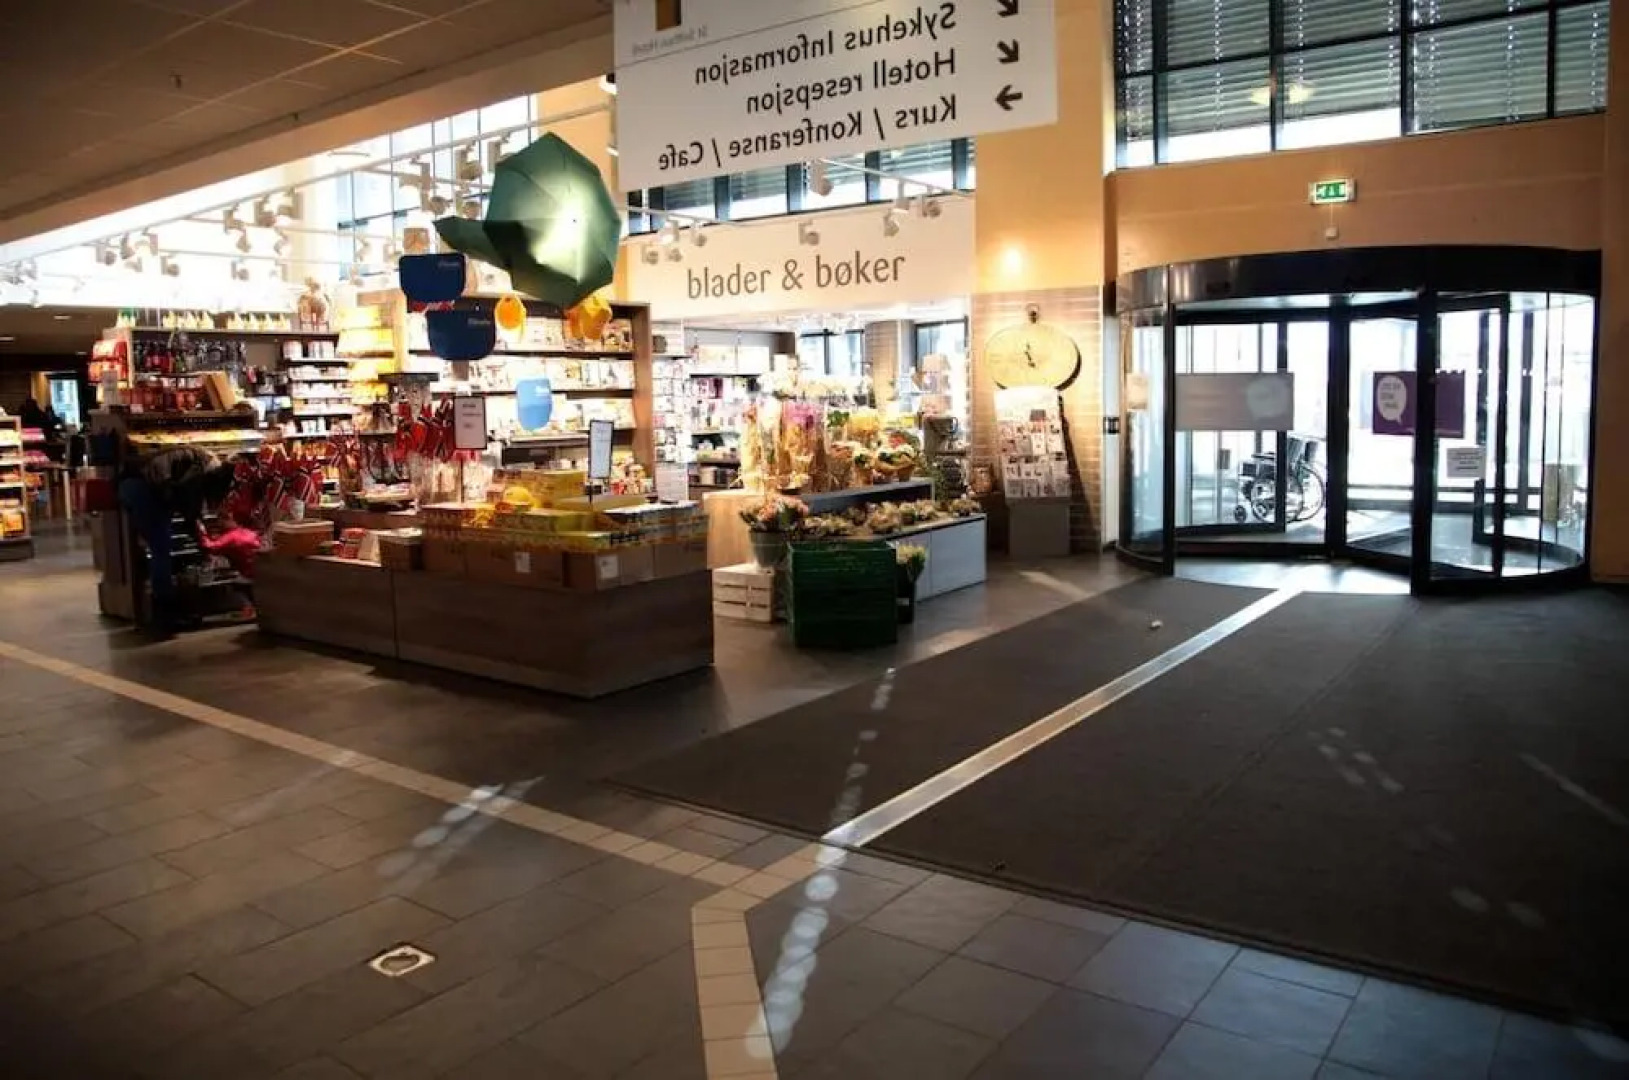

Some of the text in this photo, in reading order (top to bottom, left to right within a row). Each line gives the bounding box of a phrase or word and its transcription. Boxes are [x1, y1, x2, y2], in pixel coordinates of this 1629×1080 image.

[687, 250, 906, 299] blader & bøker
